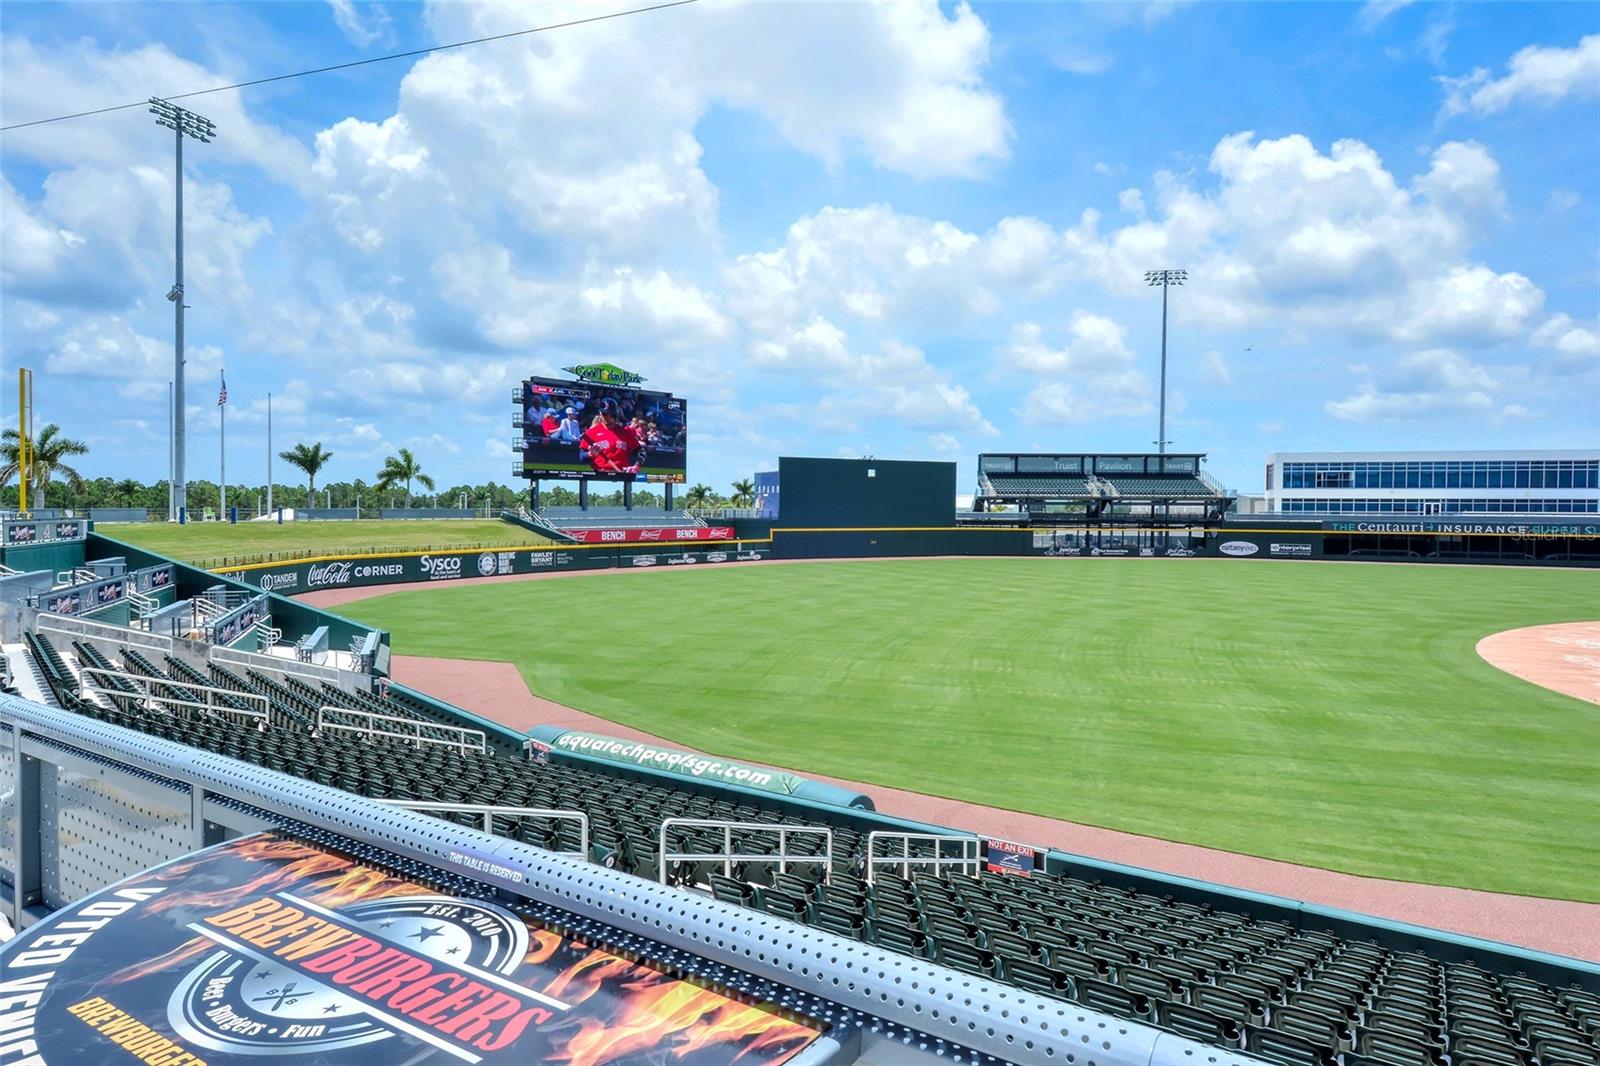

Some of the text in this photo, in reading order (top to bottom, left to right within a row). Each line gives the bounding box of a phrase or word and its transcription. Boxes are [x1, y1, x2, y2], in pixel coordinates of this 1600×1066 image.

[1055, 462, 1132, 470] Truist Pavilion
[676, 530, 698, 539] BENCH
[1332, 523, 1355, 532] THE
[1357, 521, 1424, 532] Centauri
[1438, 524, 1526, 534] INSURANCE
[602, 531, 626, 541] BENCH
[273, 573, 298, 584] TANDEM
[308, 562, 403, 586] Coca-Cola CORNER
[988, 840, 1034, 856] NOT AN EXIT
[449, 852, 523, 883] THIS TABLE IS RESERVED
[8, 887, 168, 968] VOTED
[462, 913, 503, 937] 2010
[202, 975, 326, 1039] Beer Burgers Fun
